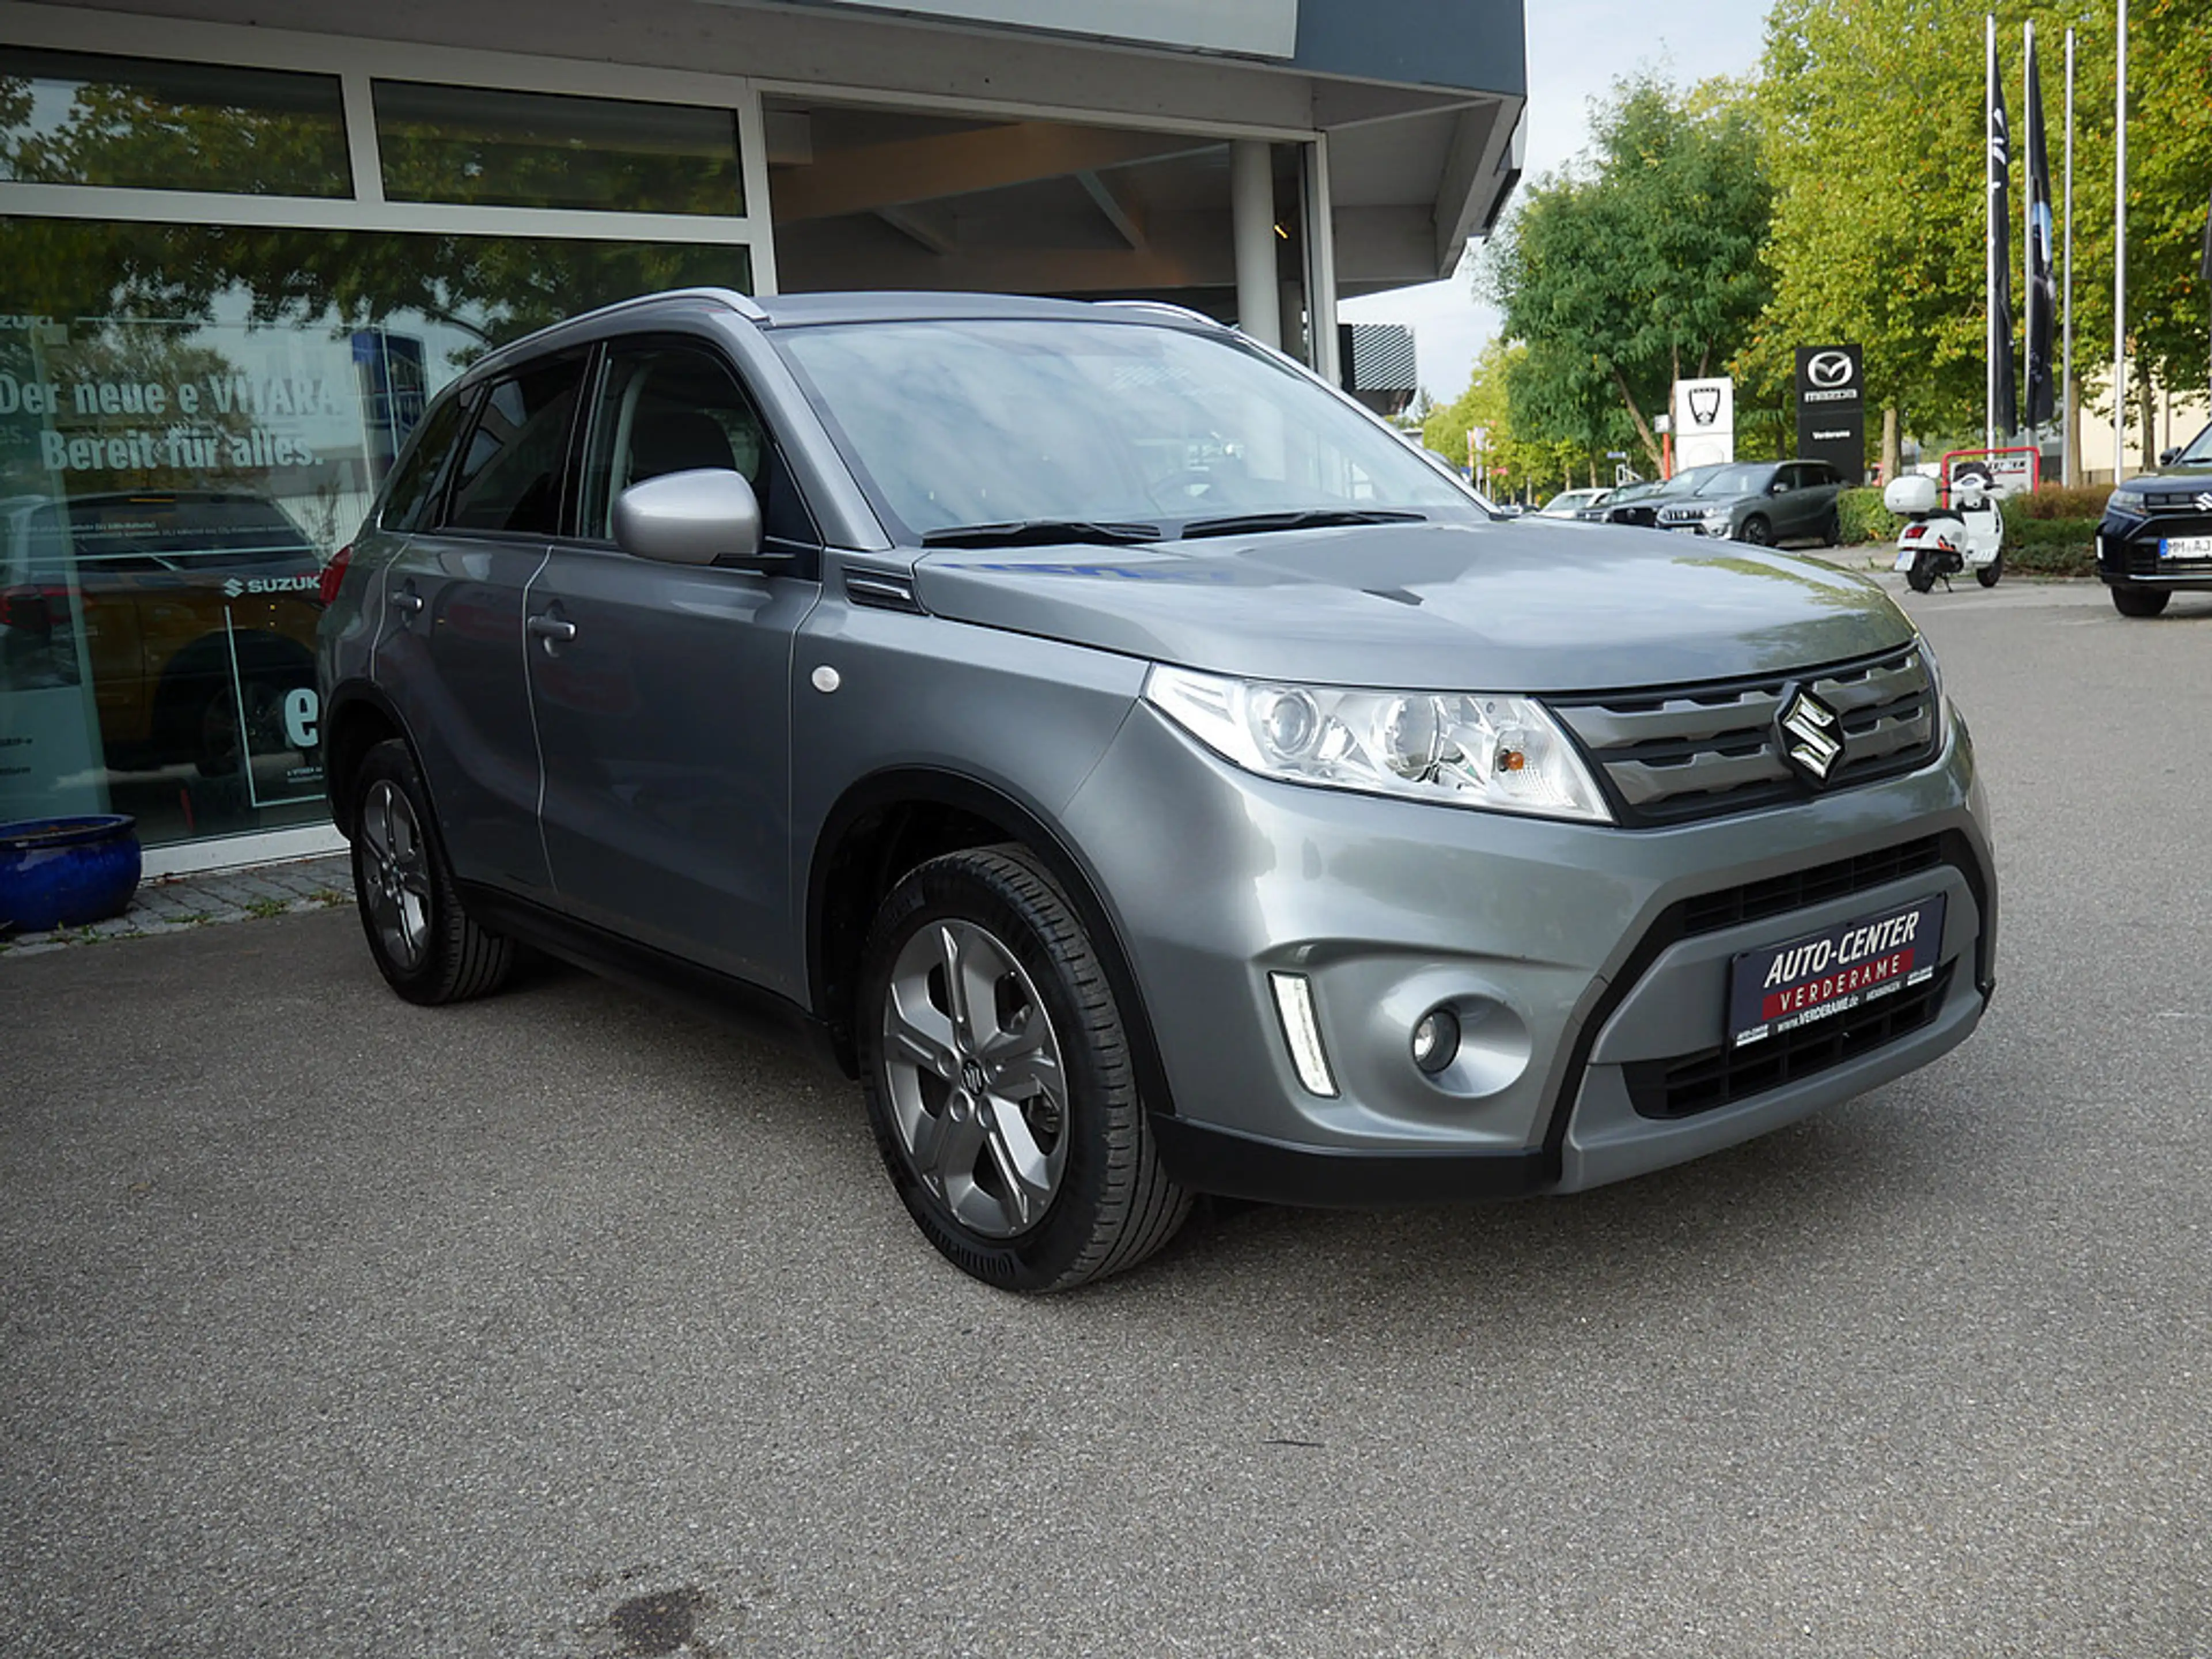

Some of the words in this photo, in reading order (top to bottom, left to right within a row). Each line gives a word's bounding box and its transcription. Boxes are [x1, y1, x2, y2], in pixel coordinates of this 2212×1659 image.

[0, 374, 59, 414] Der
[74, 382, 164, 414] neue
[179, 382, 199, 414] e
[209, 374, 343, 416] VITARA
[41, 429, 154, 470] Bereit
[169, 427, 219, 468] für
[232, 426, 324, 466] alles.
[1763, 911, 1919, 989] AUTO-CENTER
[1779, 953, 1901, 1012] VERDERAME
